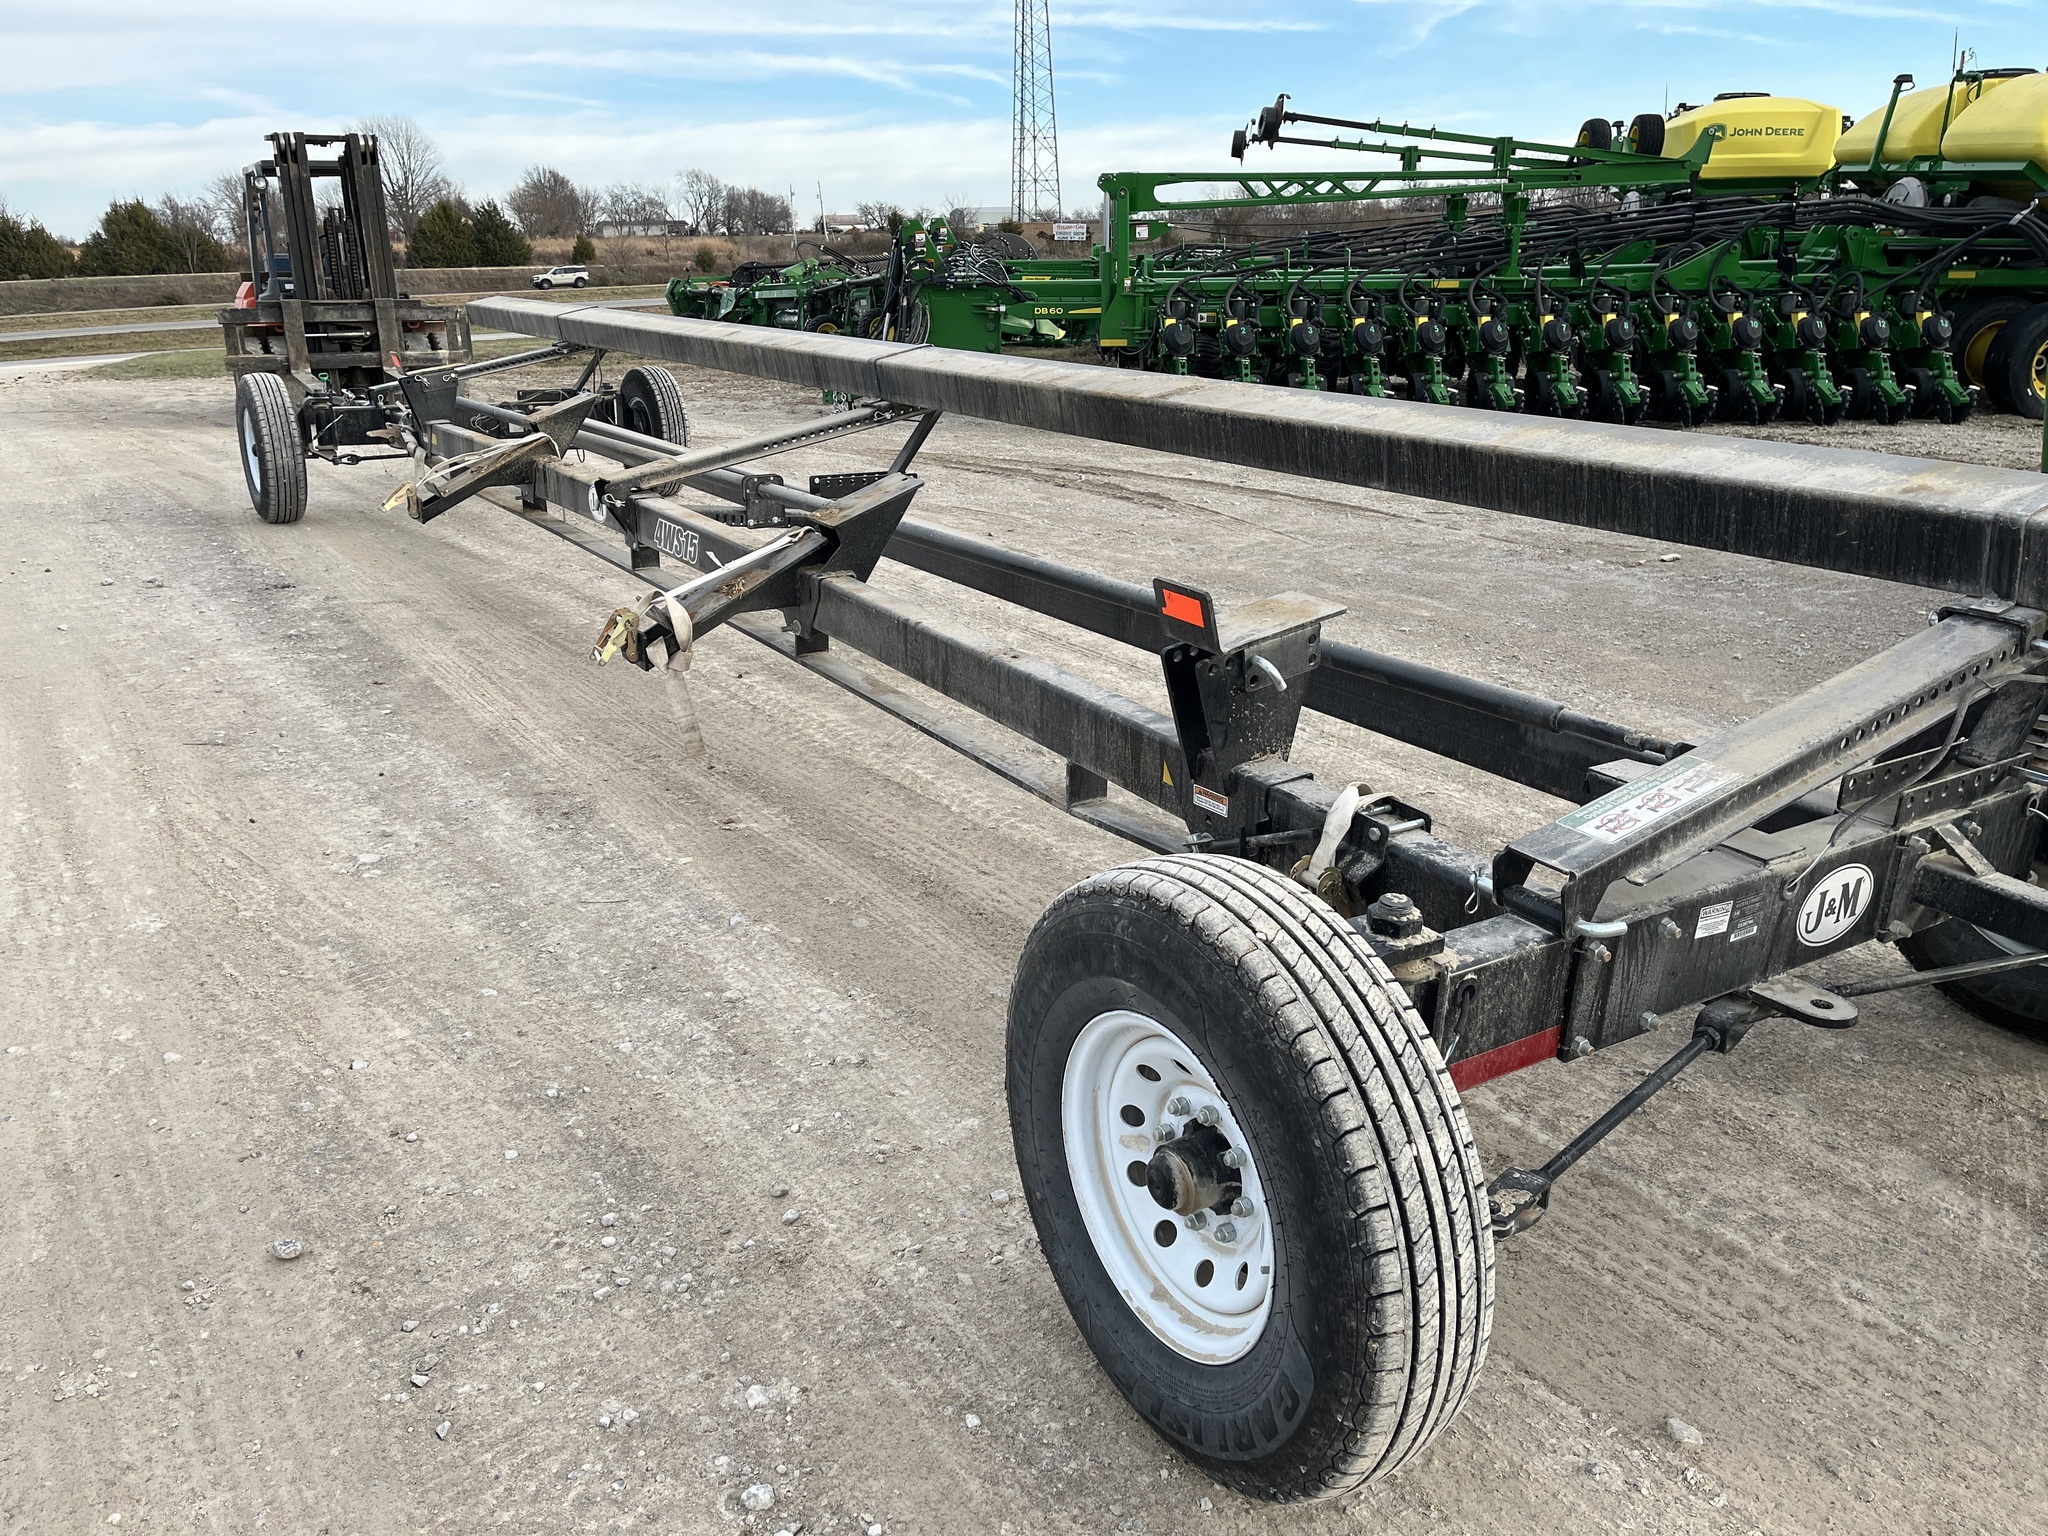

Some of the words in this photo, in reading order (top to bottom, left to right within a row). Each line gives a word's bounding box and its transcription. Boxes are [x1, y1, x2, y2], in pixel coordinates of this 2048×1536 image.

[1729, 127, 1763, 137] JOHN
[1765, 127, 1805, 136] DEERE
[1178, 323, 1183, 331] 1
[1687, 321, 1693, 329] 9
[1750, 320, 1759, 328] 10
[1816, 320, 1824, 329] 11
[1877, 319, 1886, 328] 12
[1307, 326, 1313, 334] 3
[1369, 325, 1375, 333] 4
[1434, 325, 1440, 333] 5
[1497, 324, 1503, 332] 6
[654, 518, 699, 564] 4WS15
[1805, 876, 1865, 934] J&M
[1702, 904, 1731, 918] WARNING
[1113, 1354, 1301, 1452] CARLISLE
